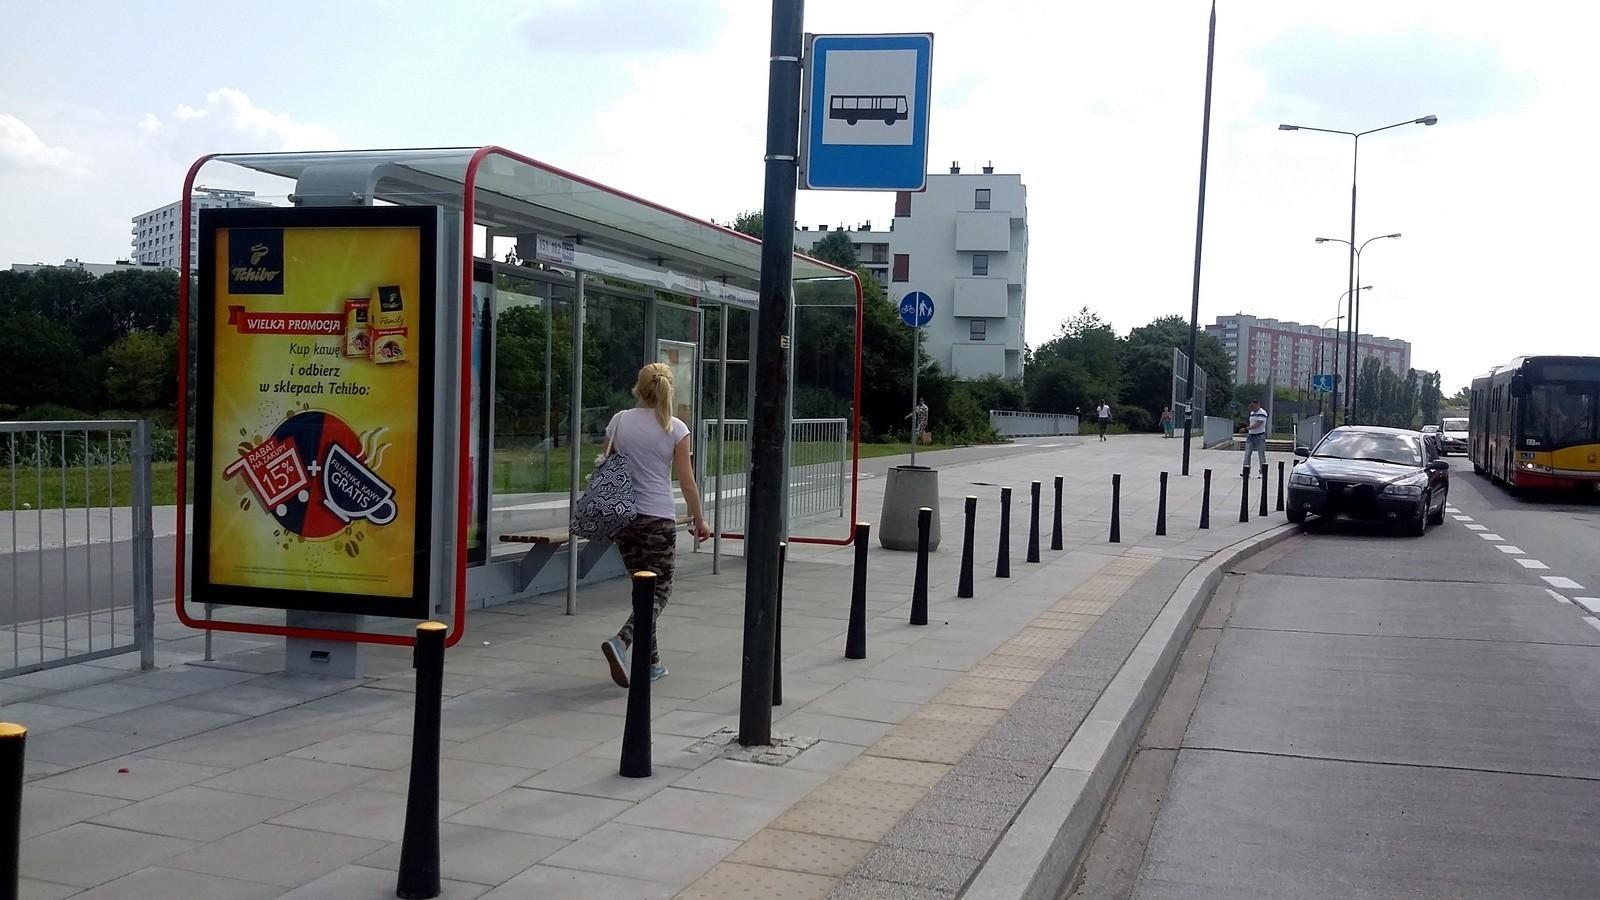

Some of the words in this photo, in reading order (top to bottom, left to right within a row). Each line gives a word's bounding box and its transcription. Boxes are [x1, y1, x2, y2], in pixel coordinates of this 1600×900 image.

[231, 267, 281, 282] Tchibo
[247, 319, 285, 330] WIELKA
[288, 319, 341, 333] PROMOCJA
[289, 342, 310, 356] Kup
[313, 343, 341, 358] kawę
[290, 363, 295, 376] i
[298, 364, 341, 377] odbierz
[259, 383, 270, 393] w
[273, 380, 324, 396] sklepach
[329, 382, 371, 395] Tchibo:
[249, 440, 276, 463] RABAT
[252, 459, 264, 471] NA
[262, 443, 287, 464] ZAKUPY
[263, 460, 294, 494] 15%
[331, 472, 371, 508] GRATIS
[361, 485, 382, 502] KAWY
